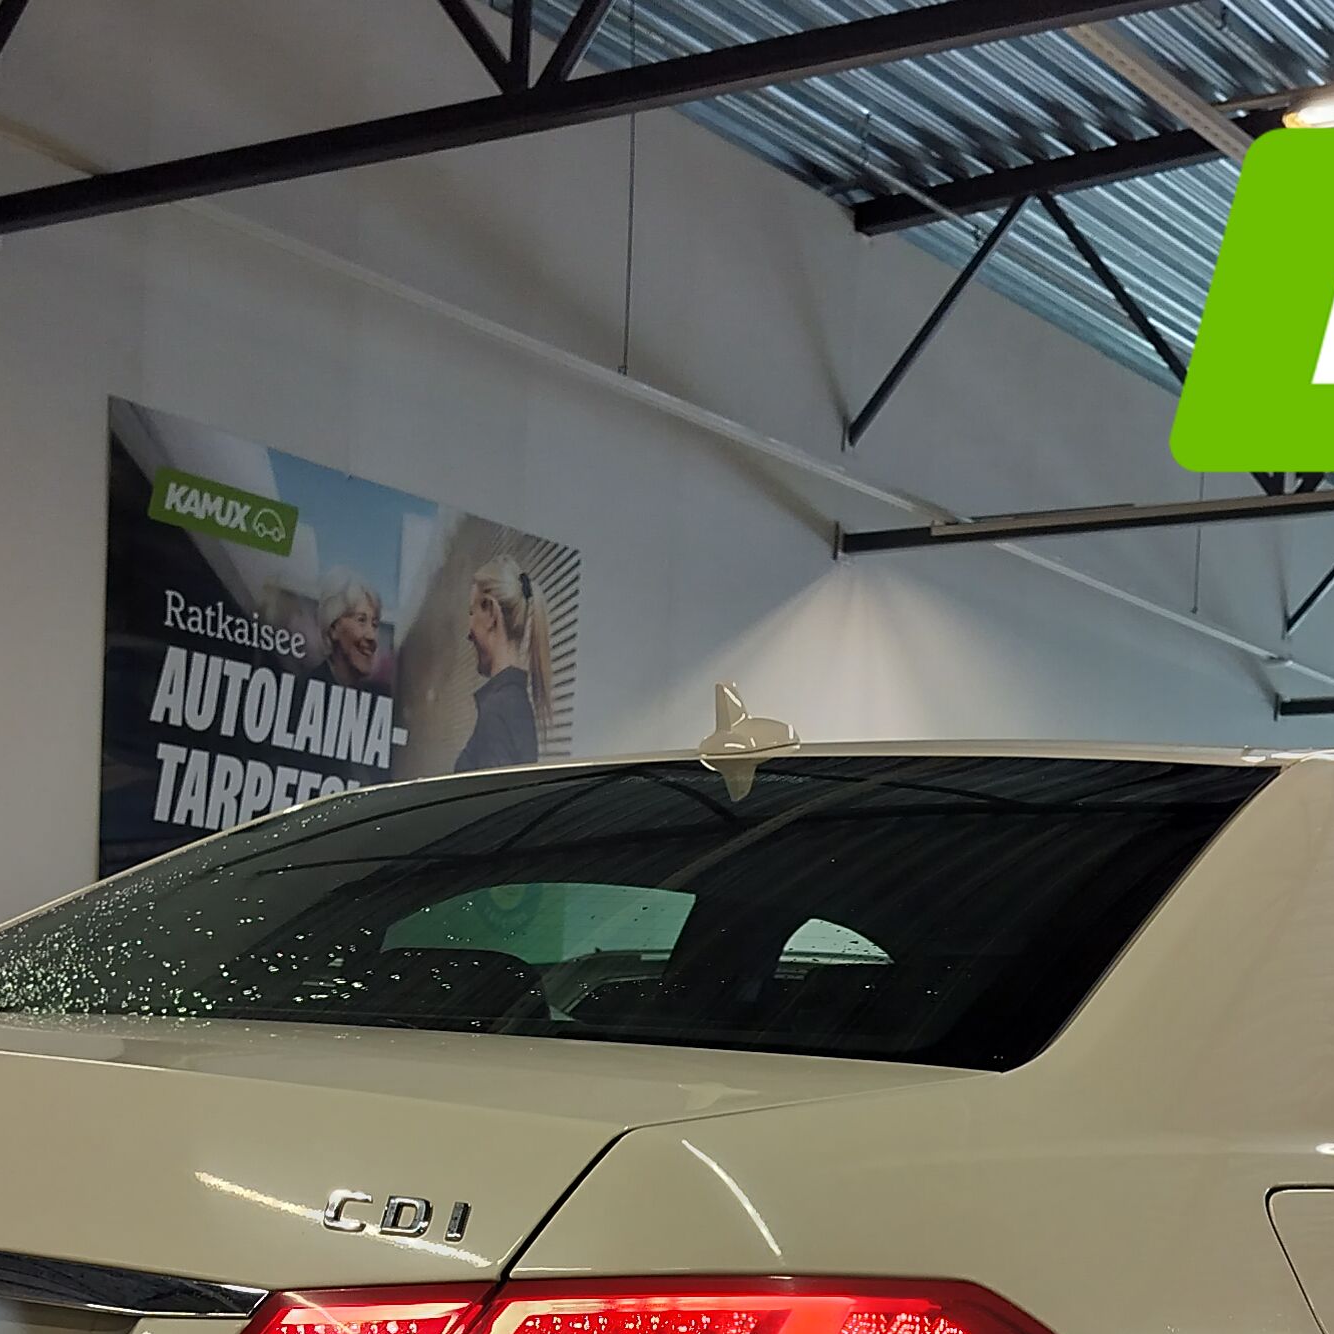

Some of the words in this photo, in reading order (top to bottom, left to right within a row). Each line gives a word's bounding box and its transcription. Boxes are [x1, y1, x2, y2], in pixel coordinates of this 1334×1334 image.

[164, 482, 251, 532] KAMUX
[164, 590, 306, 658] Ratkaisee
[150, 645, 409, 769] AUTOLAINA-
[323, 1189, 472, 1242] CDI
